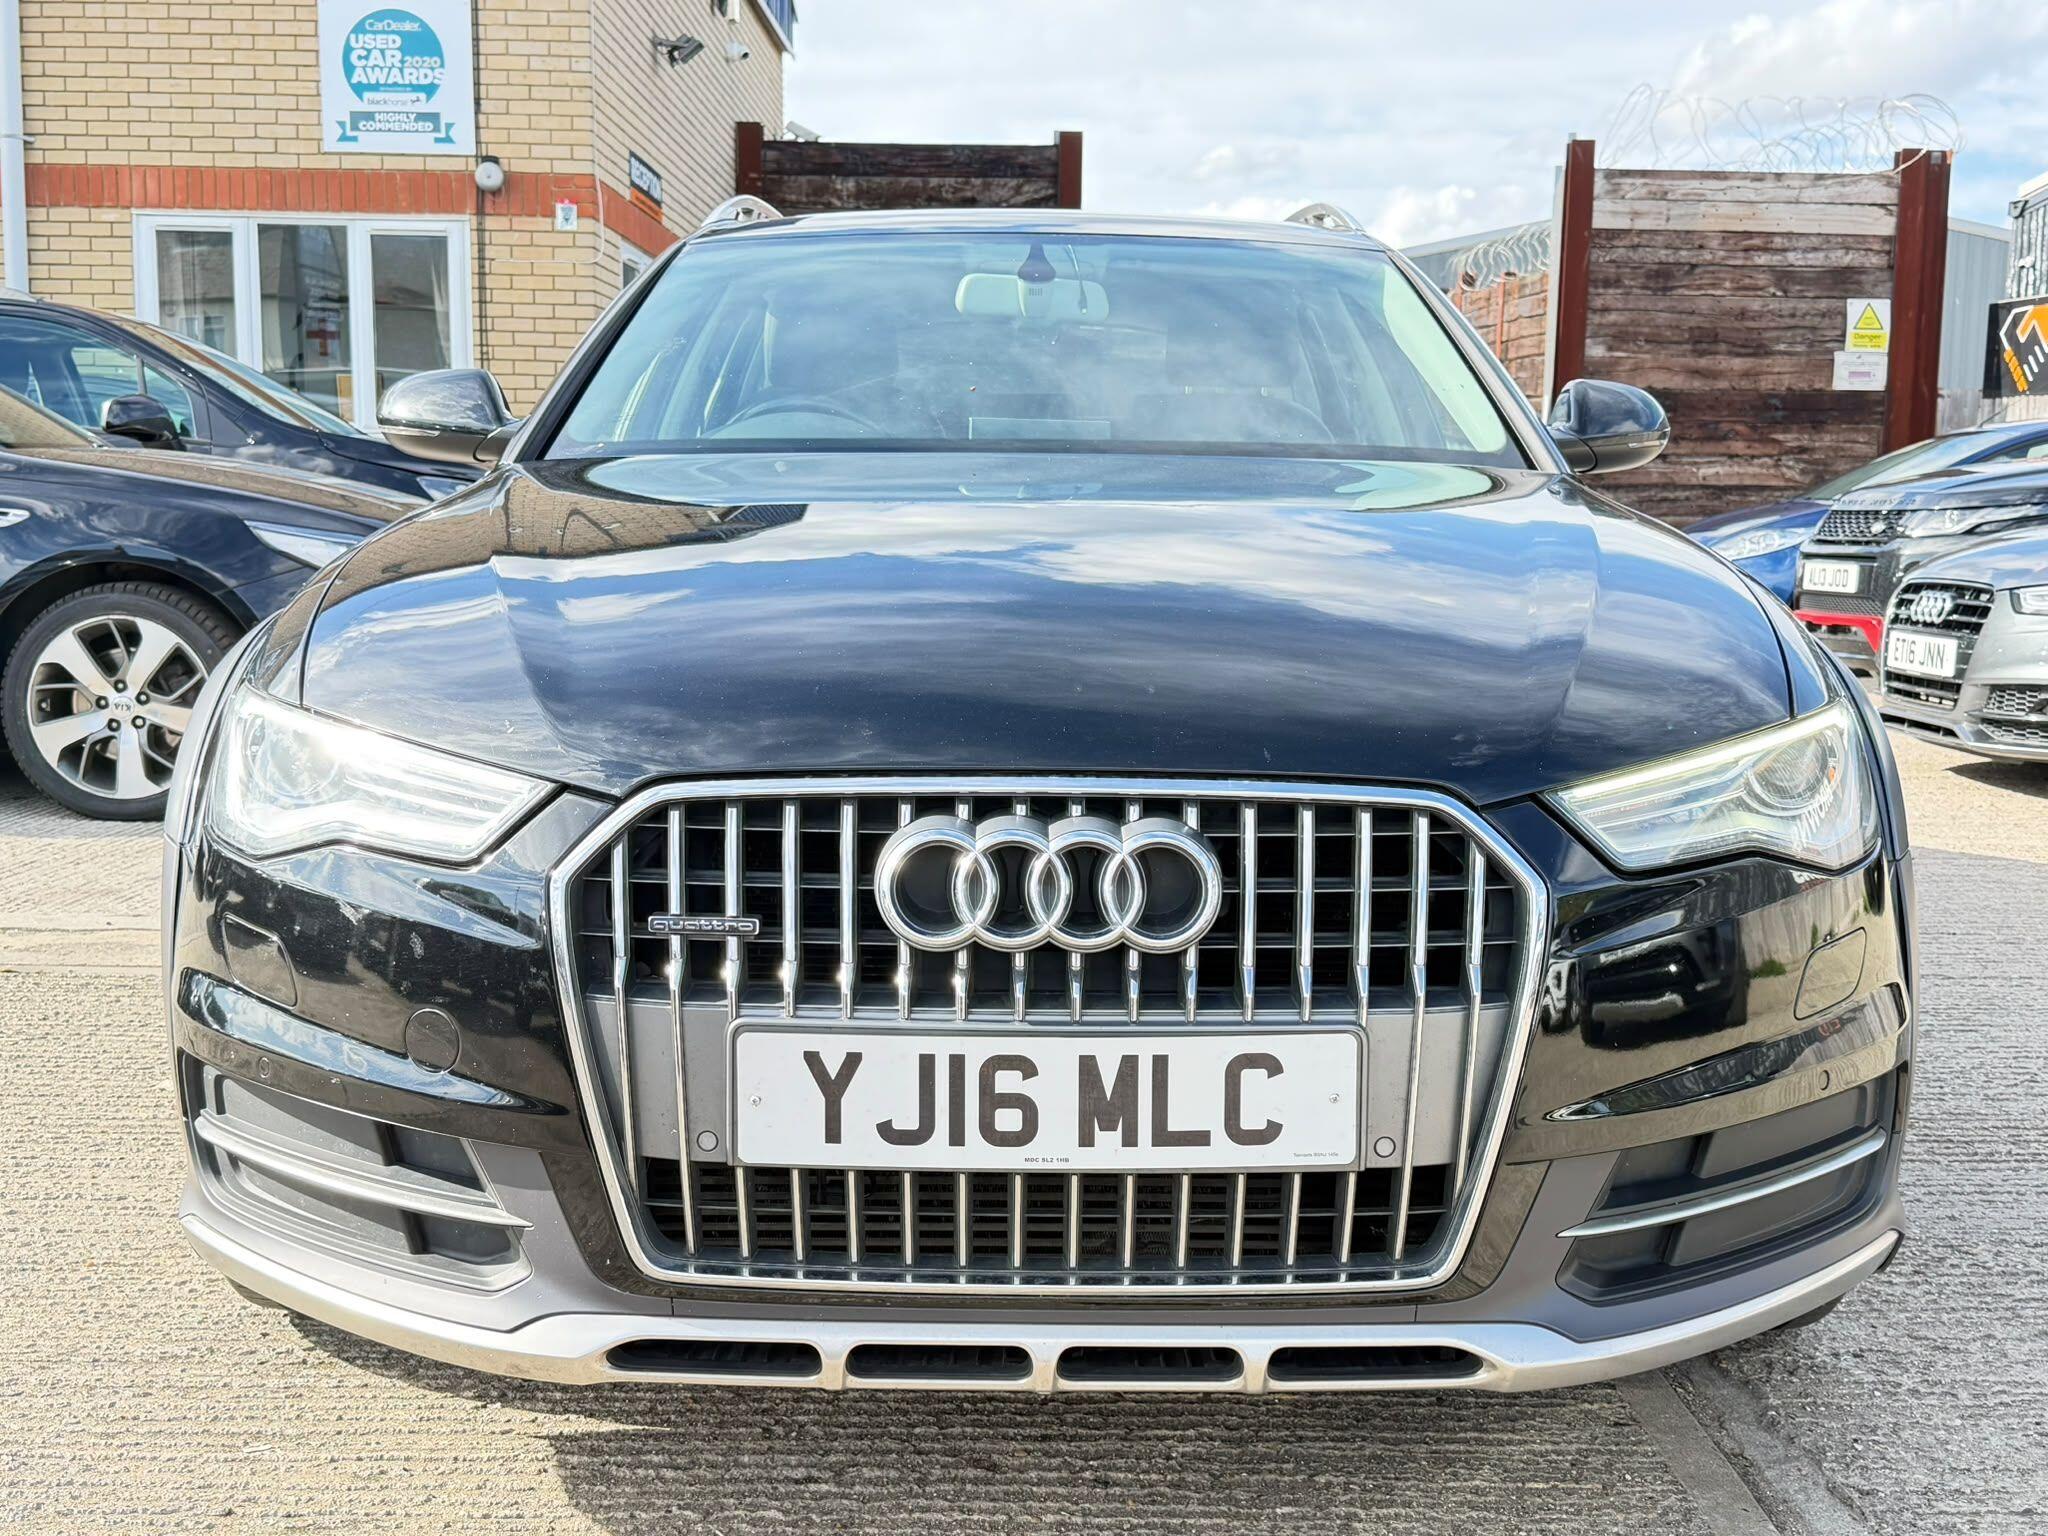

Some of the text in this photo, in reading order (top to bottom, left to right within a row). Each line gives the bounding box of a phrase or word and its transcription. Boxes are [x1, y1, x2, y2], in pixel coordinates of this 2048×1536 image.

[350, 33, 402, 48] USED
[350, 49, 441, 67] CAR 2020
[351, 67, 446, 85] AWARDS
[375, 113, 416, 122] HIGHLY
[358, 121, 434, 131] COMMENDED
[1894, 637, 1946, 669] ET16 JNN
[653, 920, 754, 931] quattro
[803, 1050, 1285, 1148] YJ16 MLC
